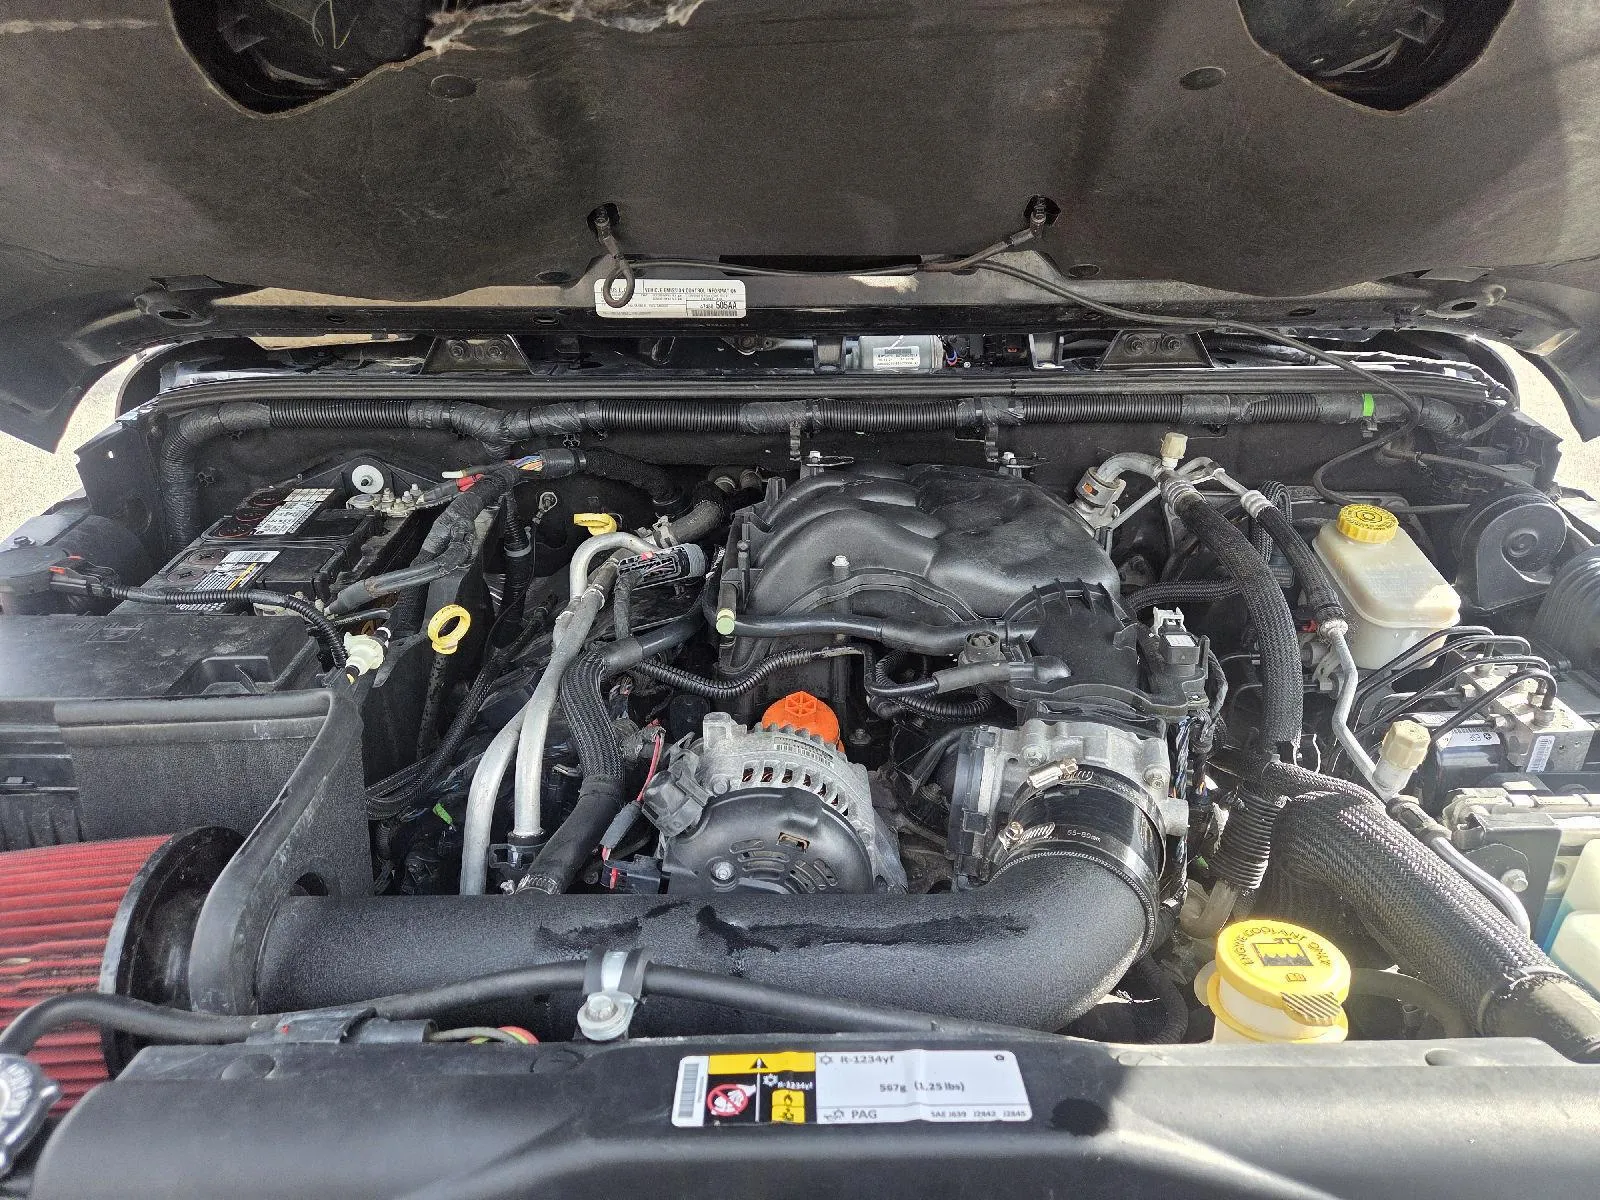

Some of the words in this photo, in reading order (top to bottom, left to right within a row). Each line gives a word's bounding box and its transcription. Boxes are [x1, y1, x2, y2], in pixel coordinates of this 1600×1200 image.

[715, 301, 737, 309] 505AA
[1243, 926, 1308, 941] COOLANT
[1233, 934, 1254, 966] ENGINE
[1307, 941, 1331, 967] ONLY
[840, 1054, 895, 1065] R-1234yf
[851, 1109, 877, 1120] PAG
[930, 1110, 946, 1118] SAE
